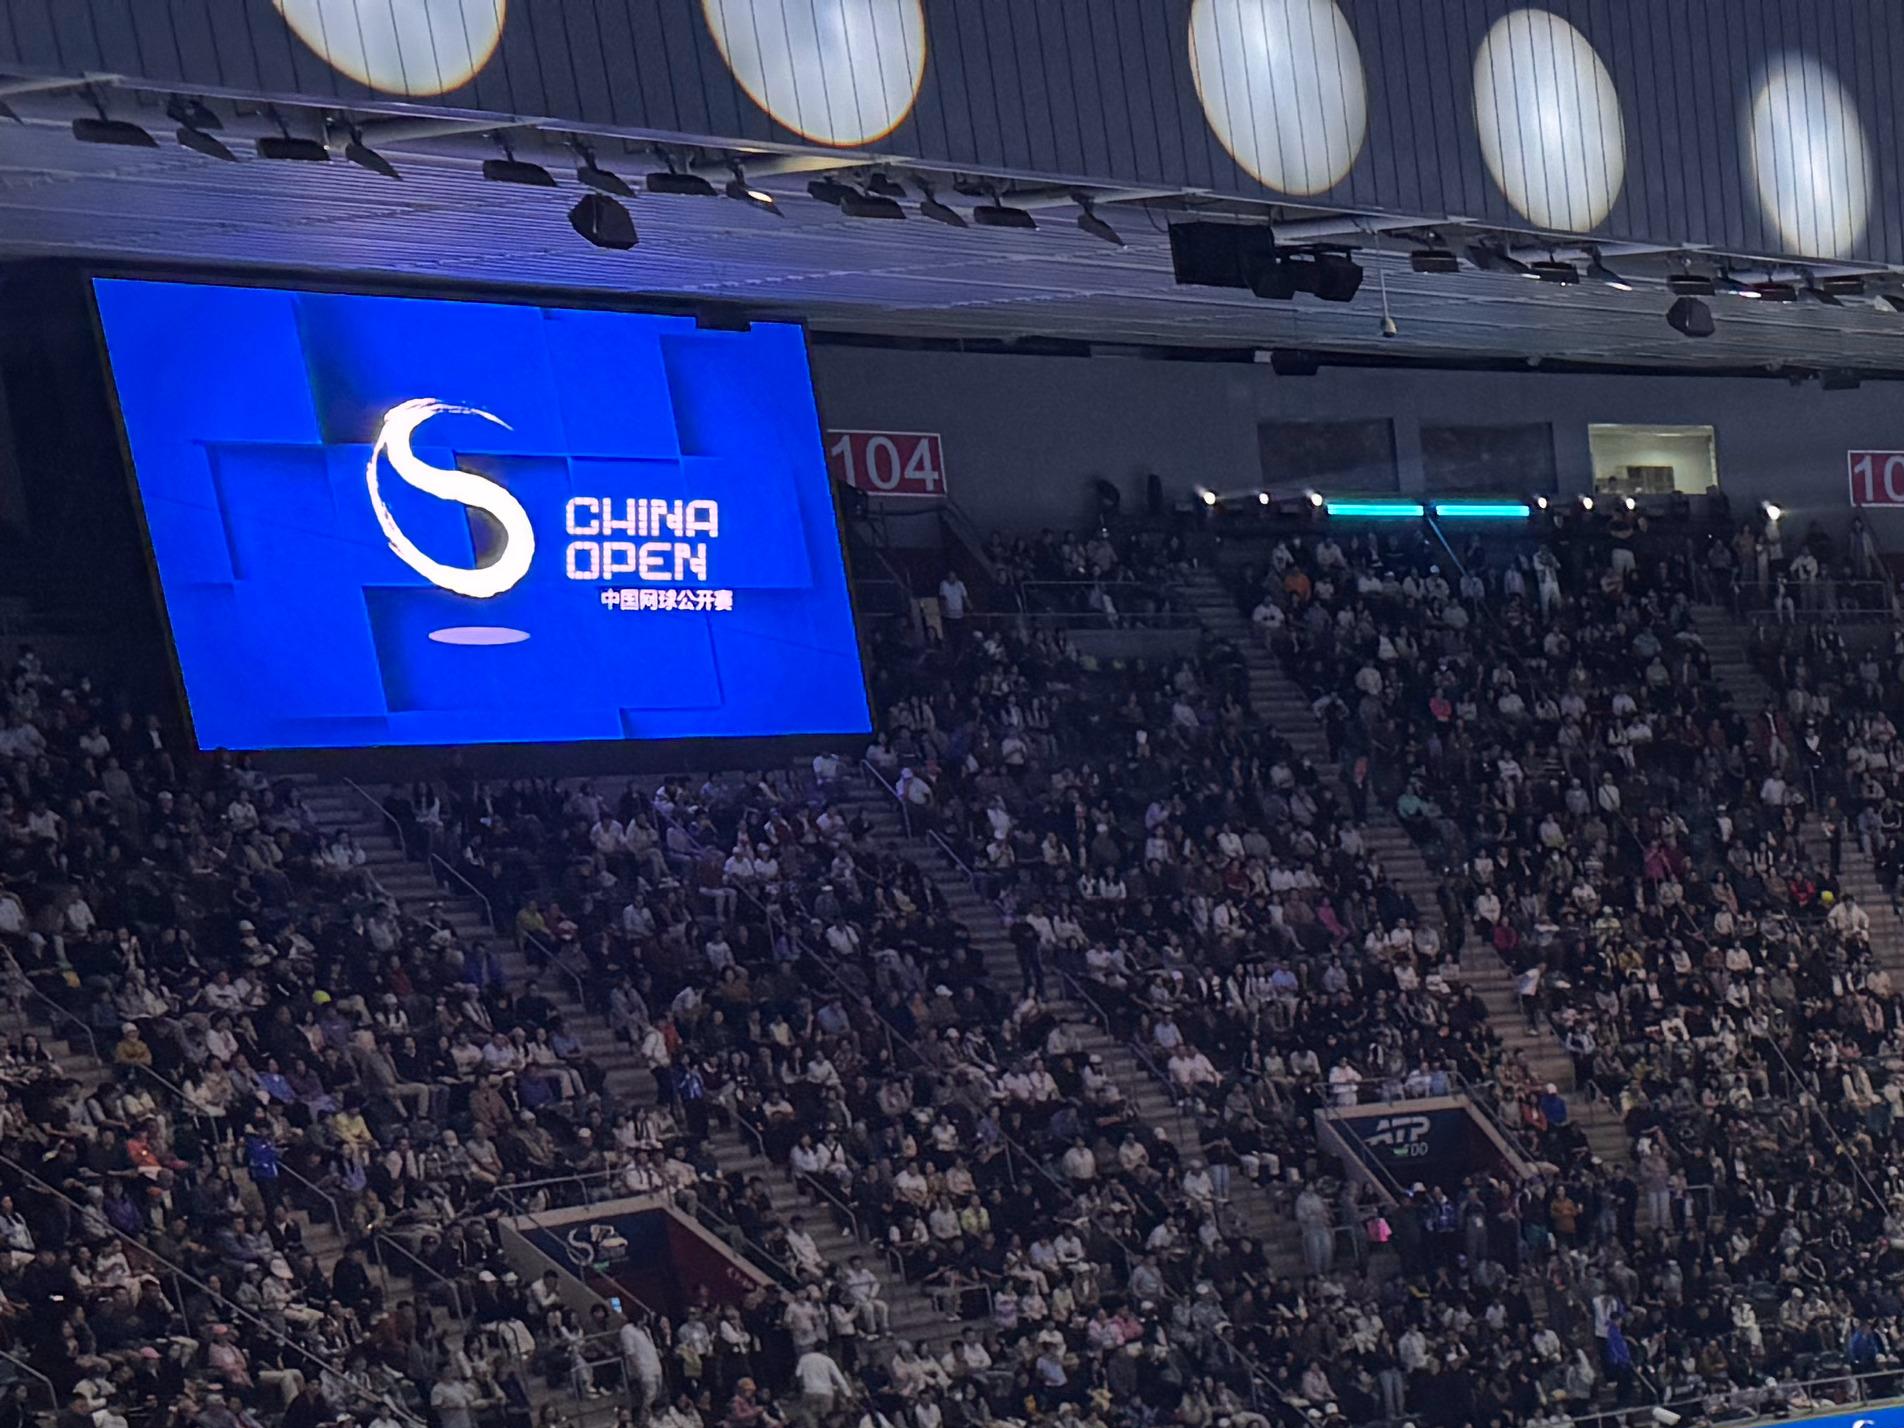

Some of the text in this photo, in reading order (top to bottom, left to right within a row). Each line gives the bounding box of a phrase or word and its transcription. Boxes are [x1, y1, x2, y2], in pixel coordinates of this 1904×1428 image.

[832, 435, 939, 491] 104
[566, 497, 718, 537] CHINA
[566, 541, 707, 580] OPEN
[601, 588, 733, 611] 中国网球公开赛
[1365, 1115, 1430, 1147] ATP
